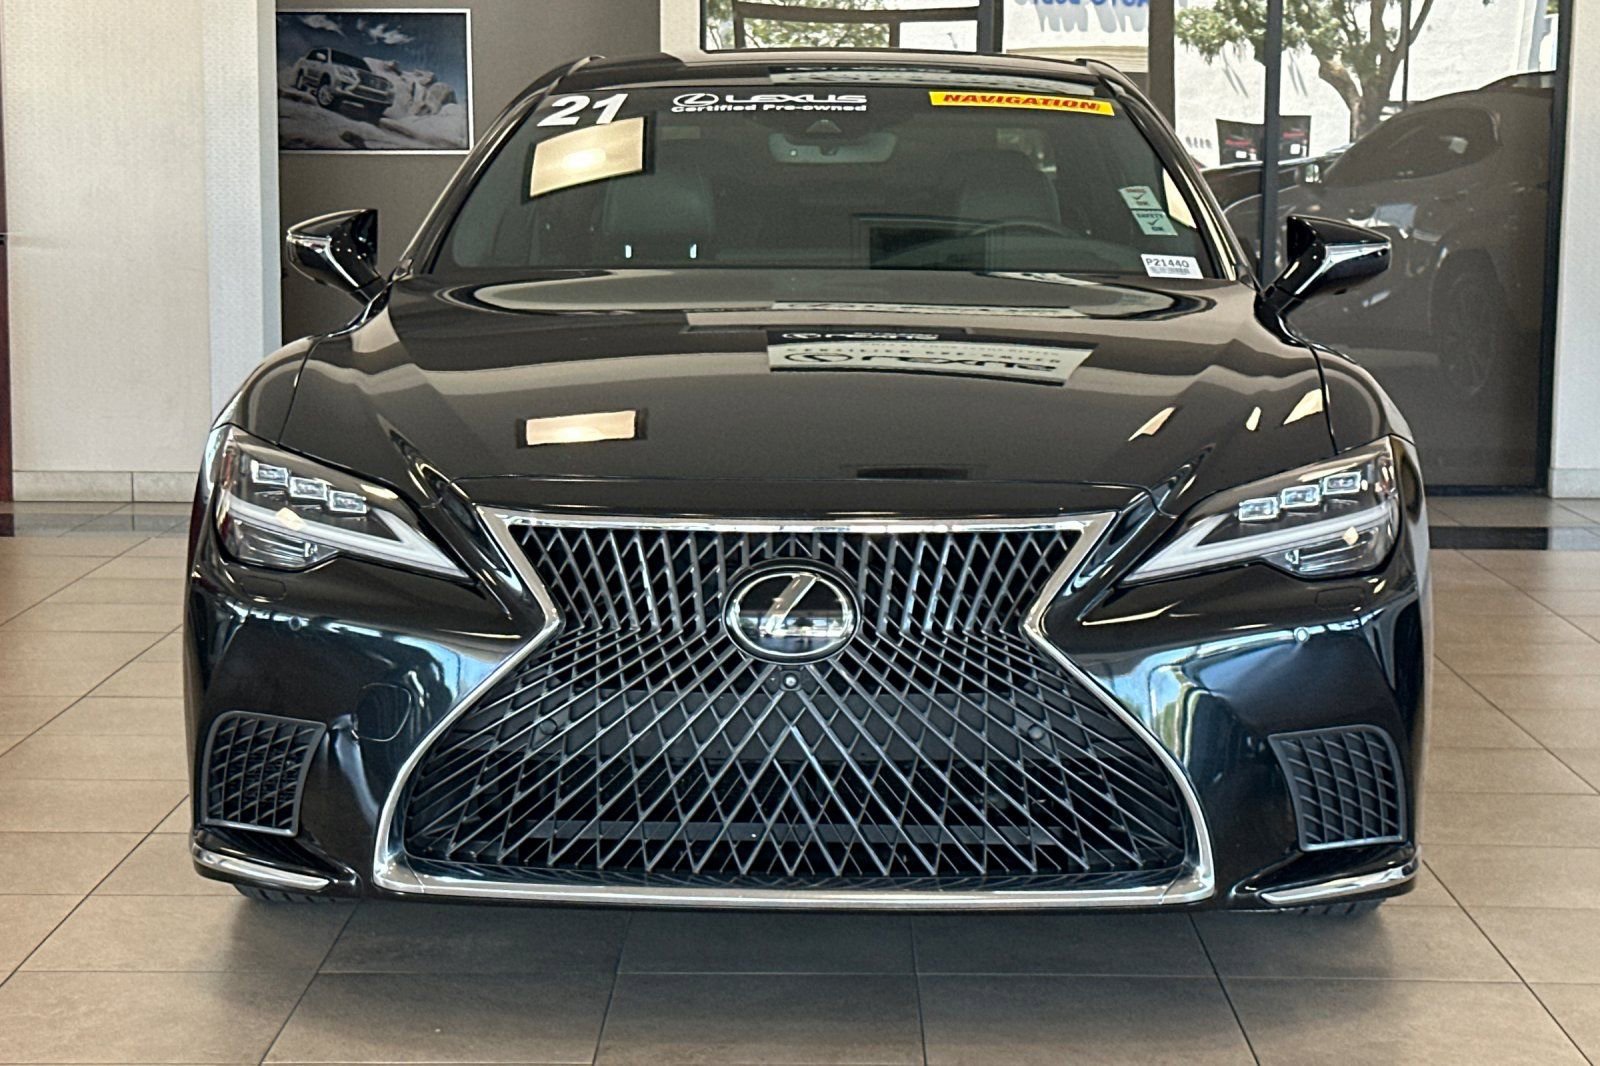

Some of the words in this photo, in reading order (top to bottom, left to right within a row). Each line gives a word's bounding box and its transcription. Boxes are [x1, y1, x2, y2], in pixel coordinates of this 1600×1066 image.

[725, 94, 868, 104] LEXUS
[943, 94, 1100, 111] NAVIGATION
[537, 93, 628, 127] 21
[671, 104, 757, 112] Certified
[763, 103, 867, 112] Pre-owned
